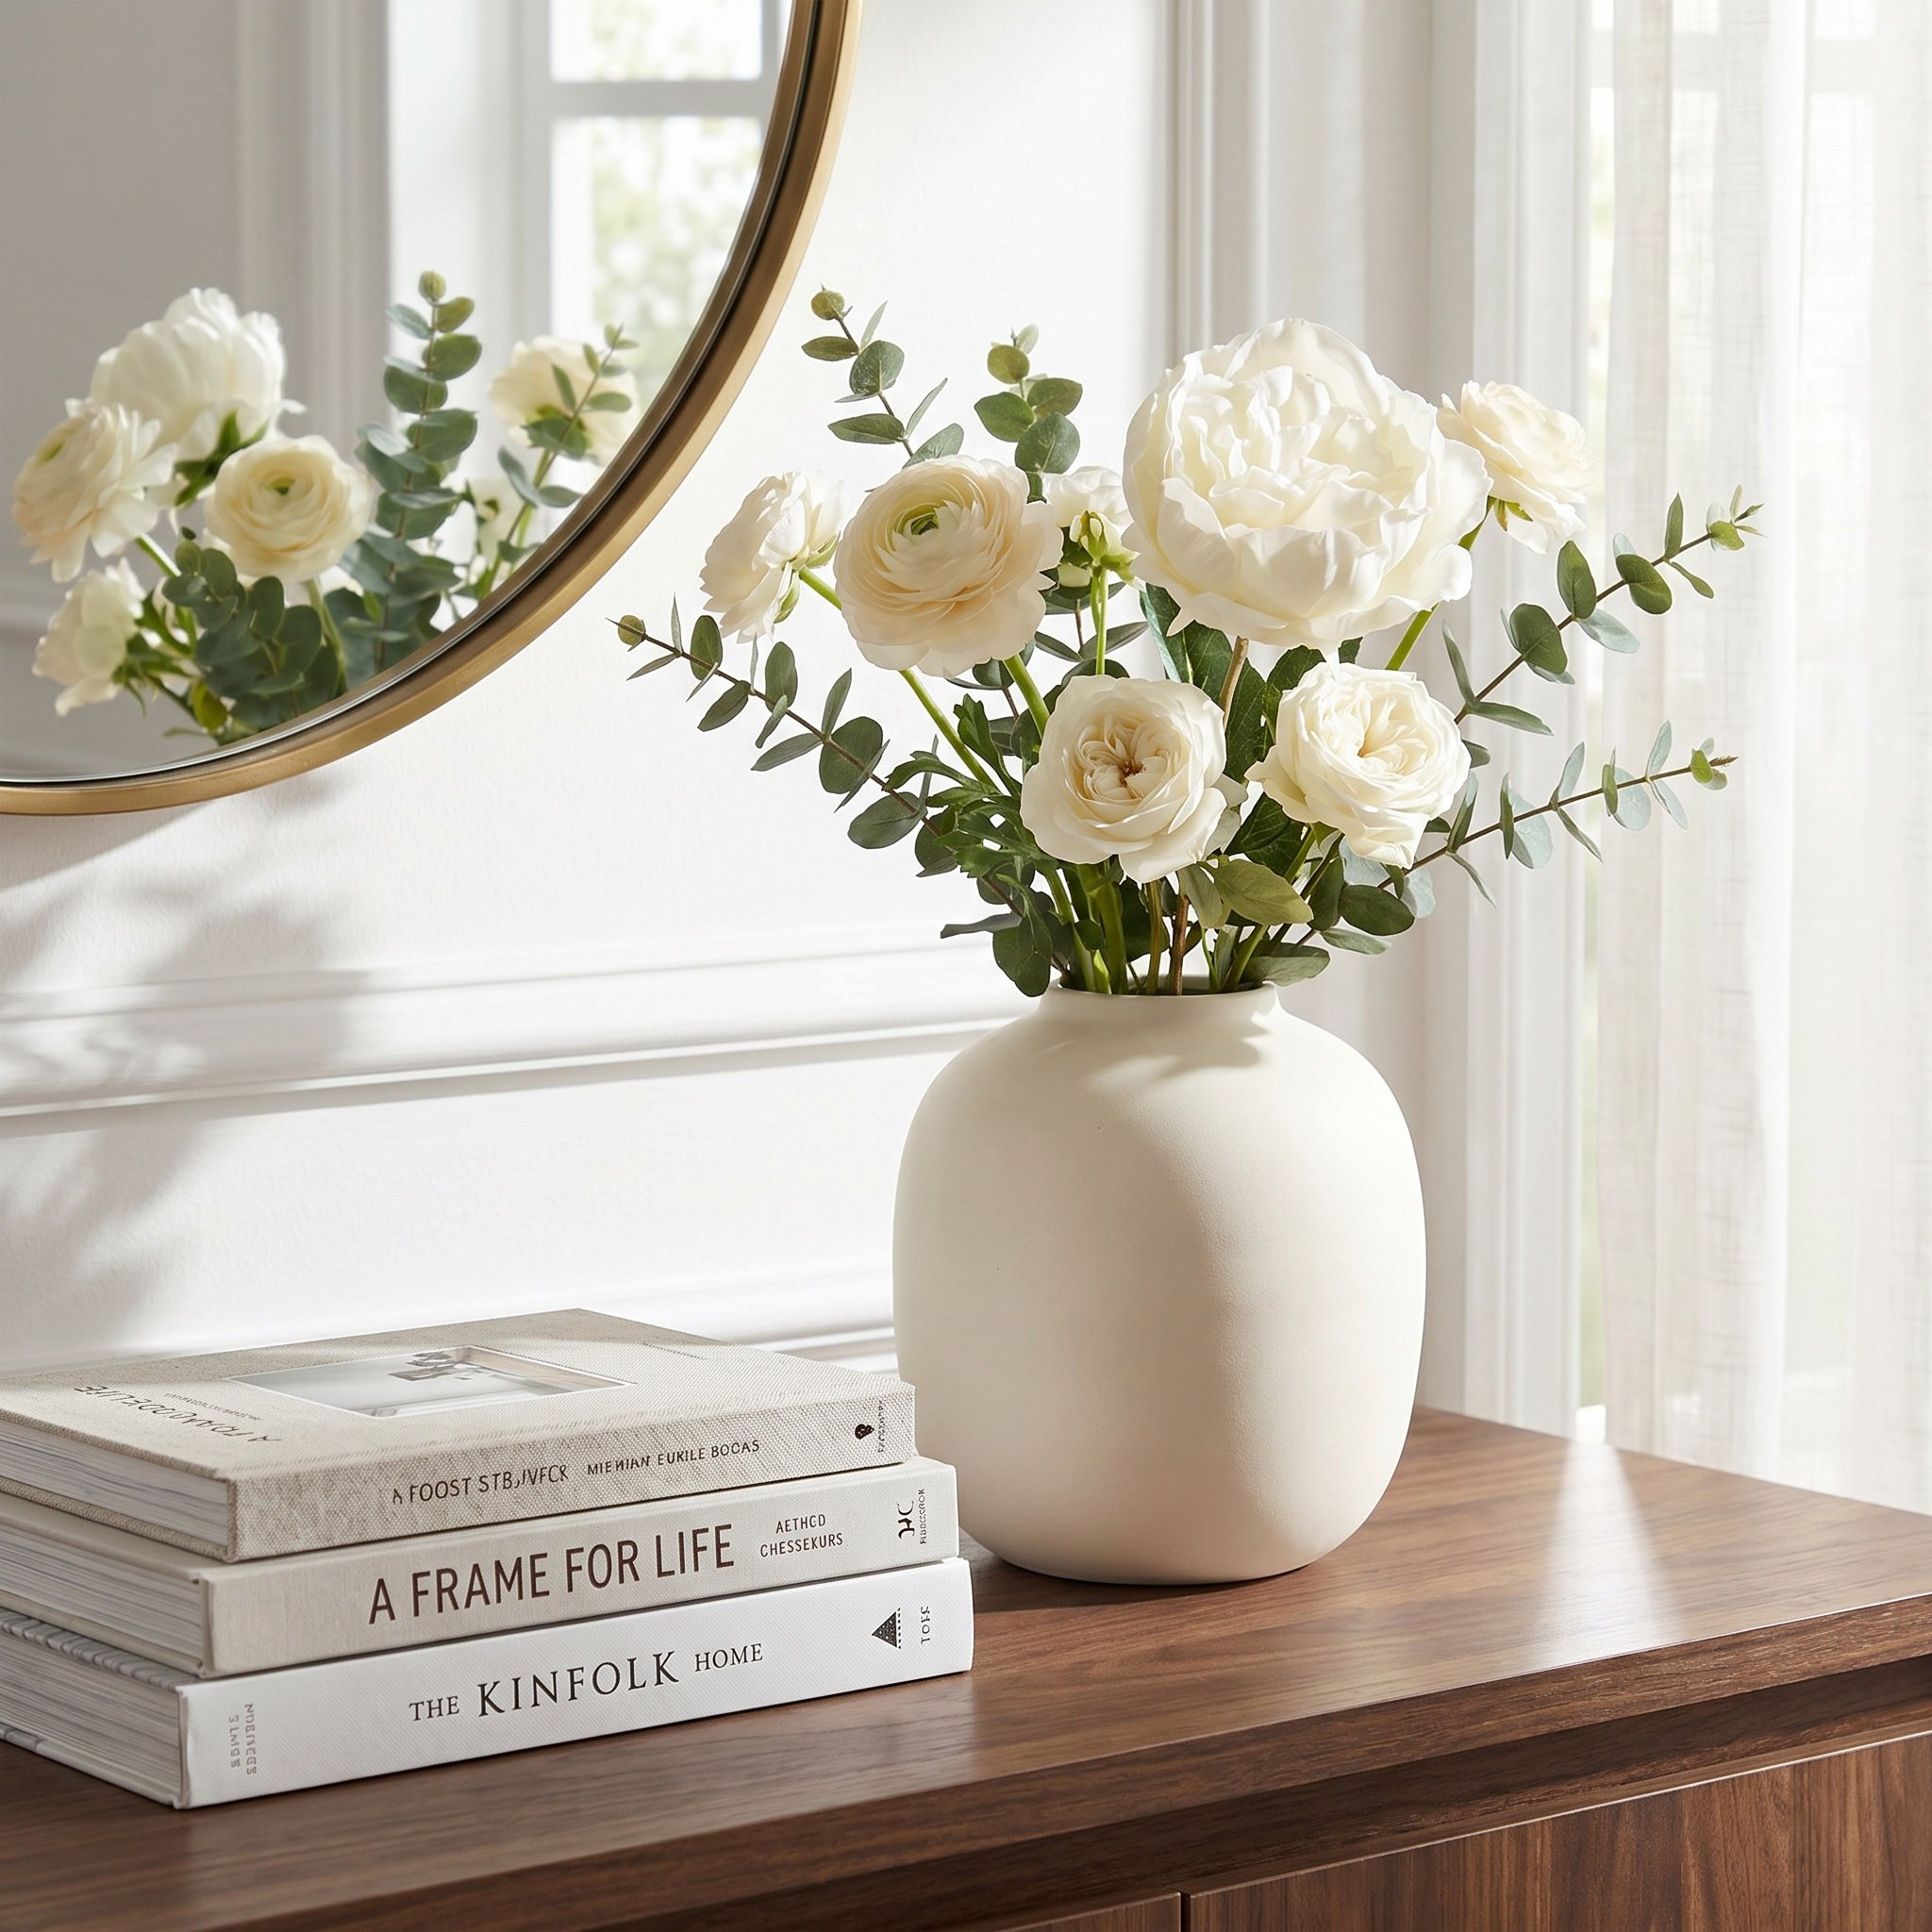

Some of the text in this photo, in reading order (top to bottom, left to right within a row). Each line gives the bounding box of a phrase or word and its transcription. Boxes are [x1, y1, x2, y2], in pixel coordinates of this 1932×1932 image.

[408, 1477, 473, 1503] FOOST
[759, 1532, 844, 1557] CHESSEKURS
[368, 1524, 735, 1624] A FRAME FOR LIFE
[408, 1642, 763, 1722] THE KINFOLK HOME
